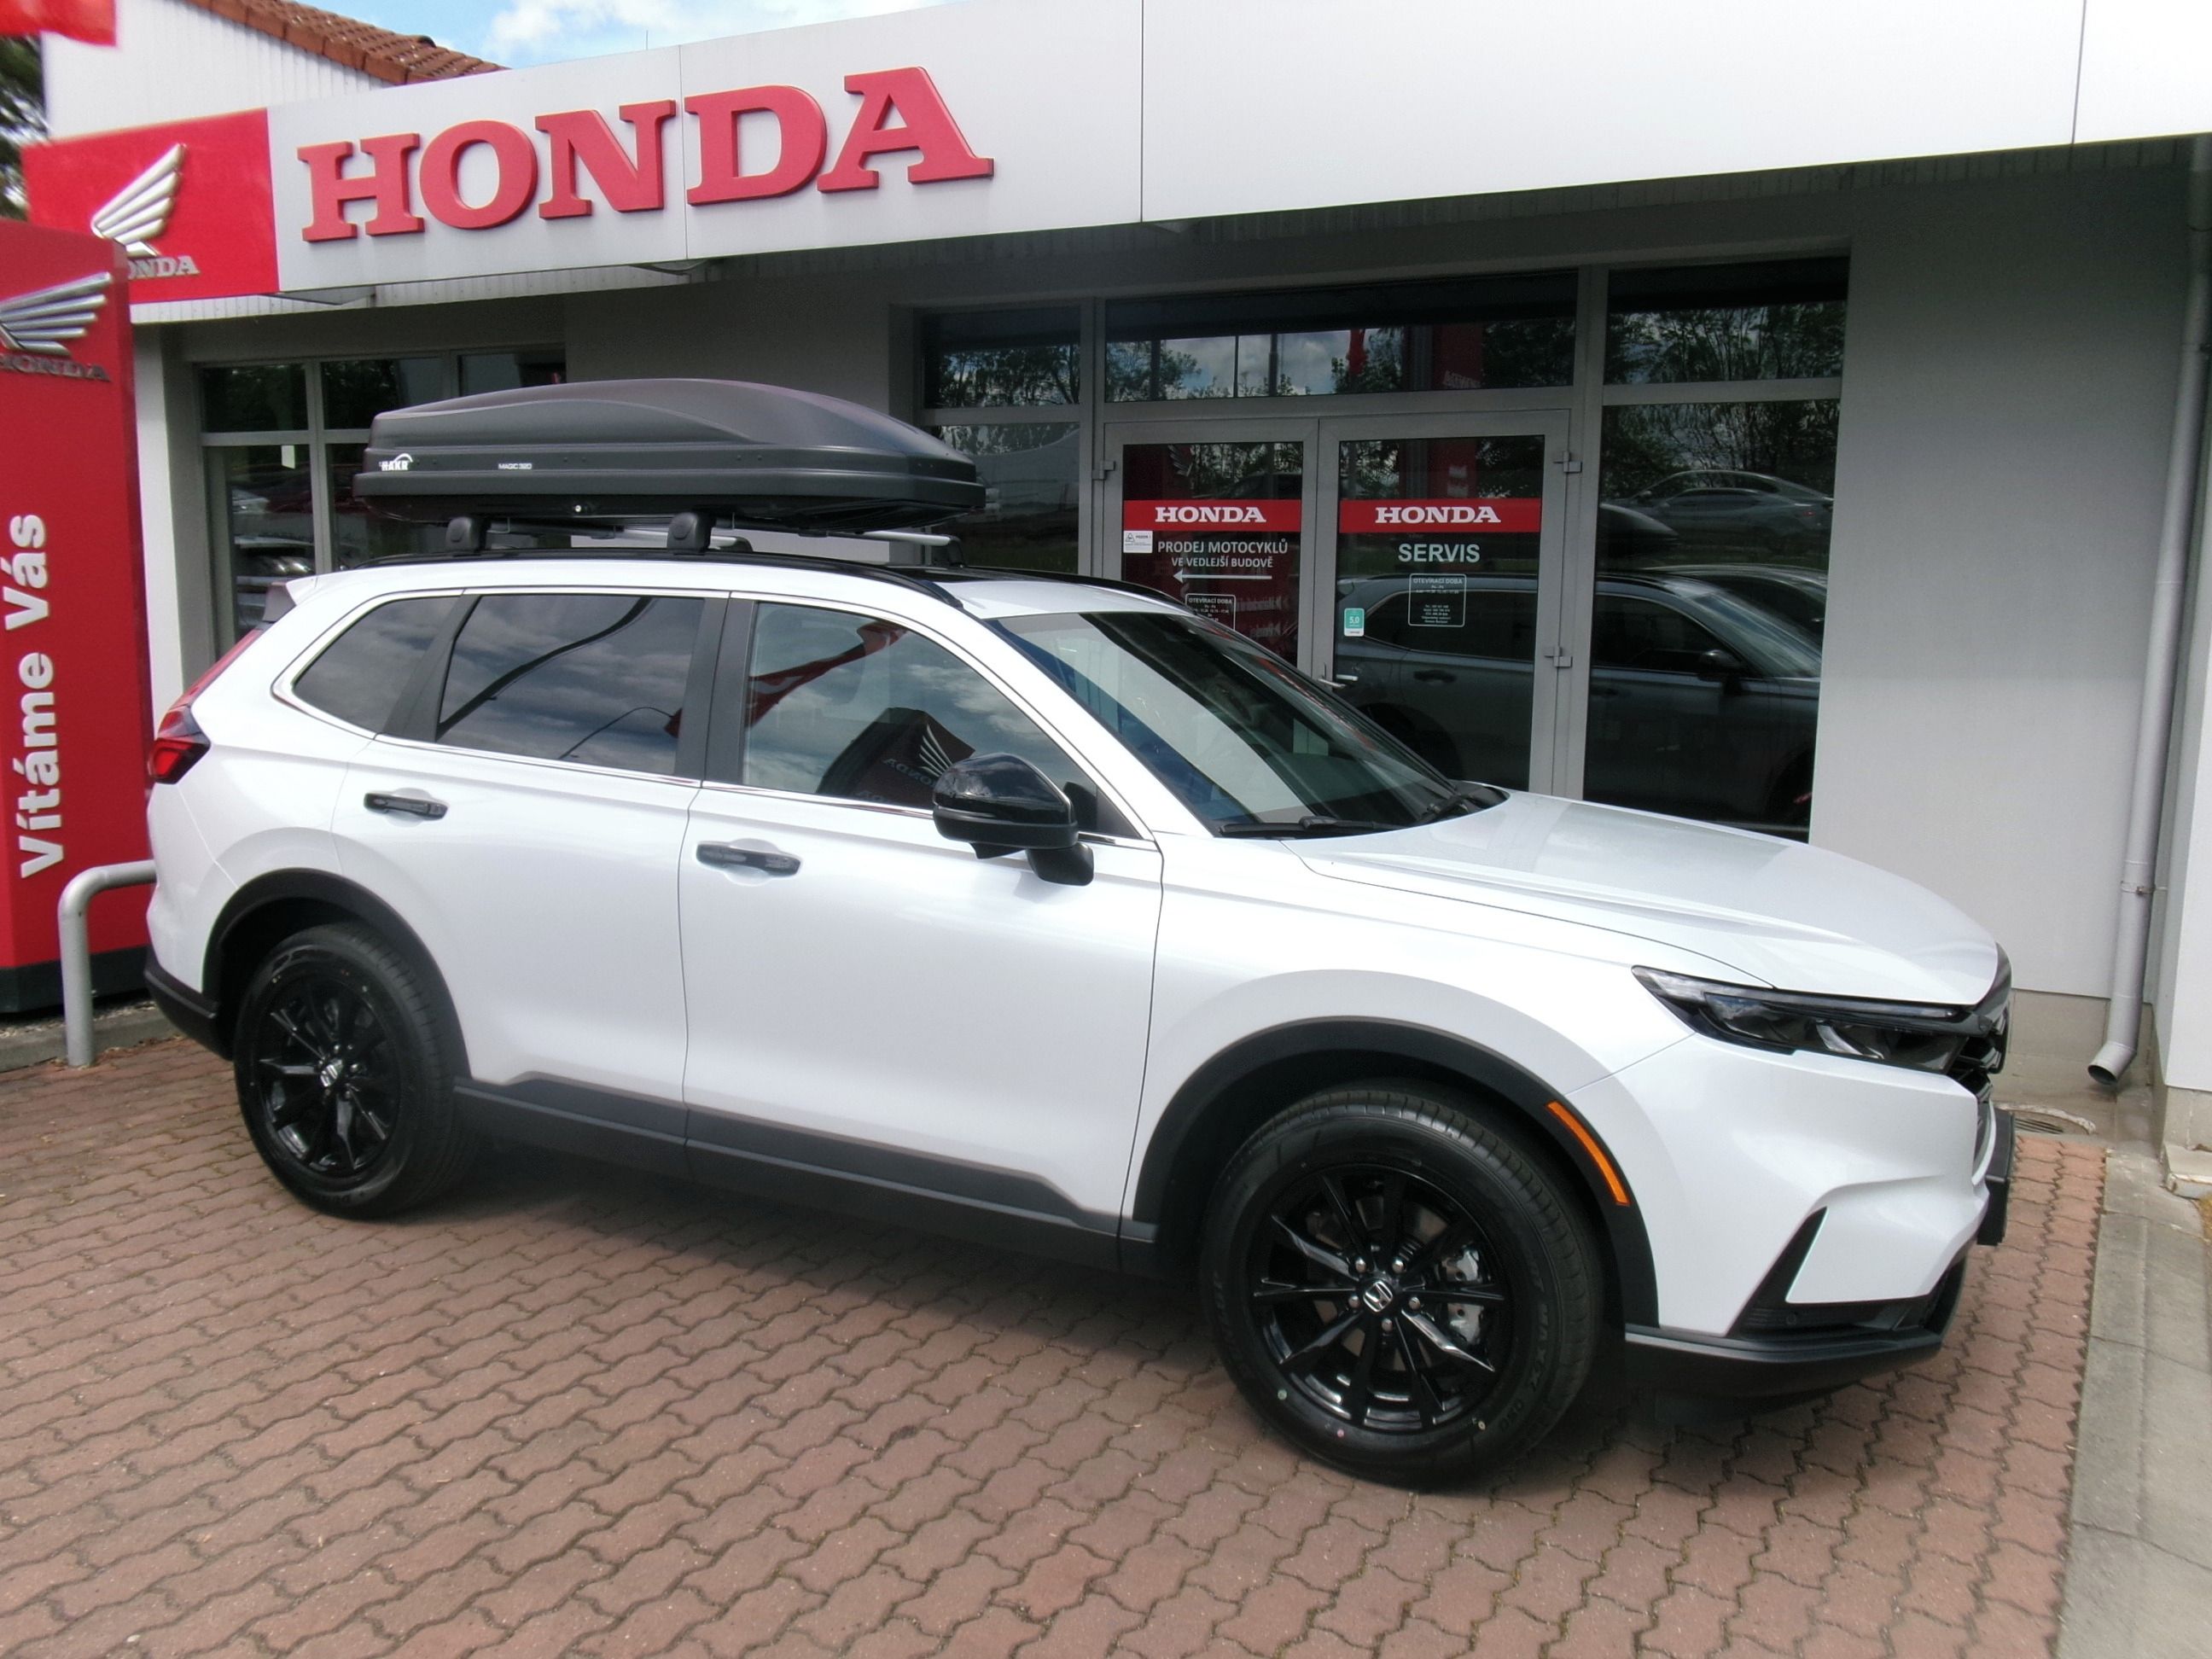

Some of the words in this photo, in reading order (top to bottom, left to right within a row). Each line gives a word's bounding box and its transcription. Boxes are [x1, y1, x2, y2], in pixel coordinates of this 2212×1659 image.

[297, 66, 994, 242] HONDA
[128, 255, 201, 280] NDA
[1155, 506, 1266, 522] HONDA
[1375, 506, 1501, 523] HONDA
[1157, 541, 1204, 553] PRODEJ
[1208, 538, 1289, 554] MOTOCYKLŮ
[1398, 543, 1481, 562] SERVIS
[1171, 557, 1184, 567] VE
[1186, 556, 1229, 568] VEDLEJŠÍ
[1231, 556, 1273, 568] BUDOVĚ
[0, 514, 49, 631] Vás
[13, 652, 64, 879] Vítáme
